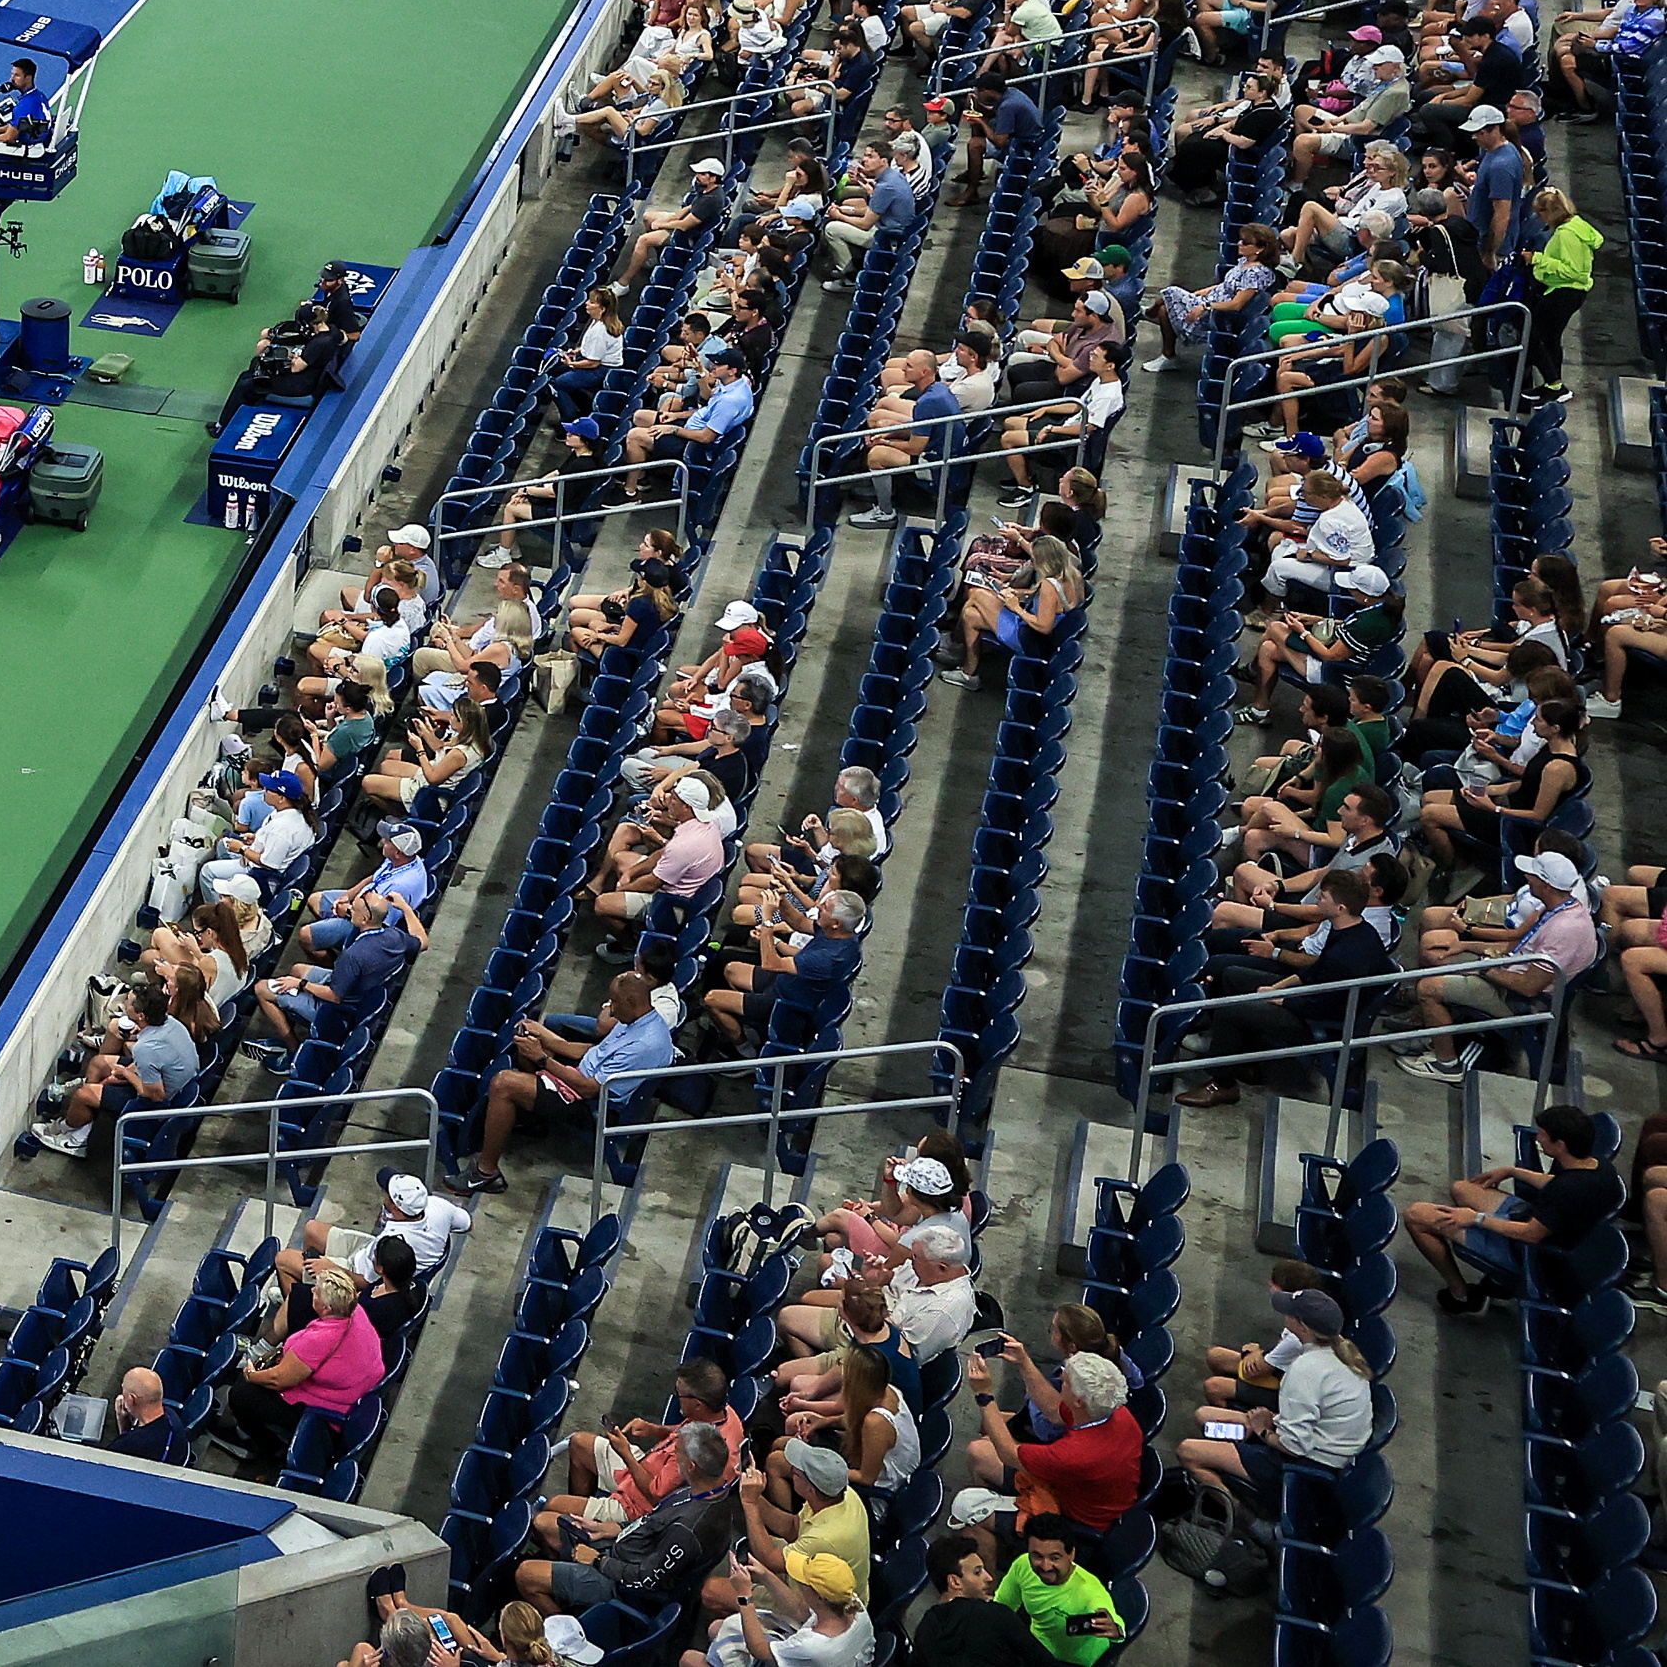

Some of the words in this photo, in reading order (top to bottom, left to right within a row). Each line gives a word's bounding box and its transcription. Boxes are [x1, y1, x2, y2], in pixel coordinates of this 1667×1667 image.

[15, 16, 52, 43] CHUBB
[54, 151, 77, 180] CHUBB
[117, 265, 173, 290] POLO
[234, 412, 282, 451] Wilson
[217, 473, 270, 493] Wilson
